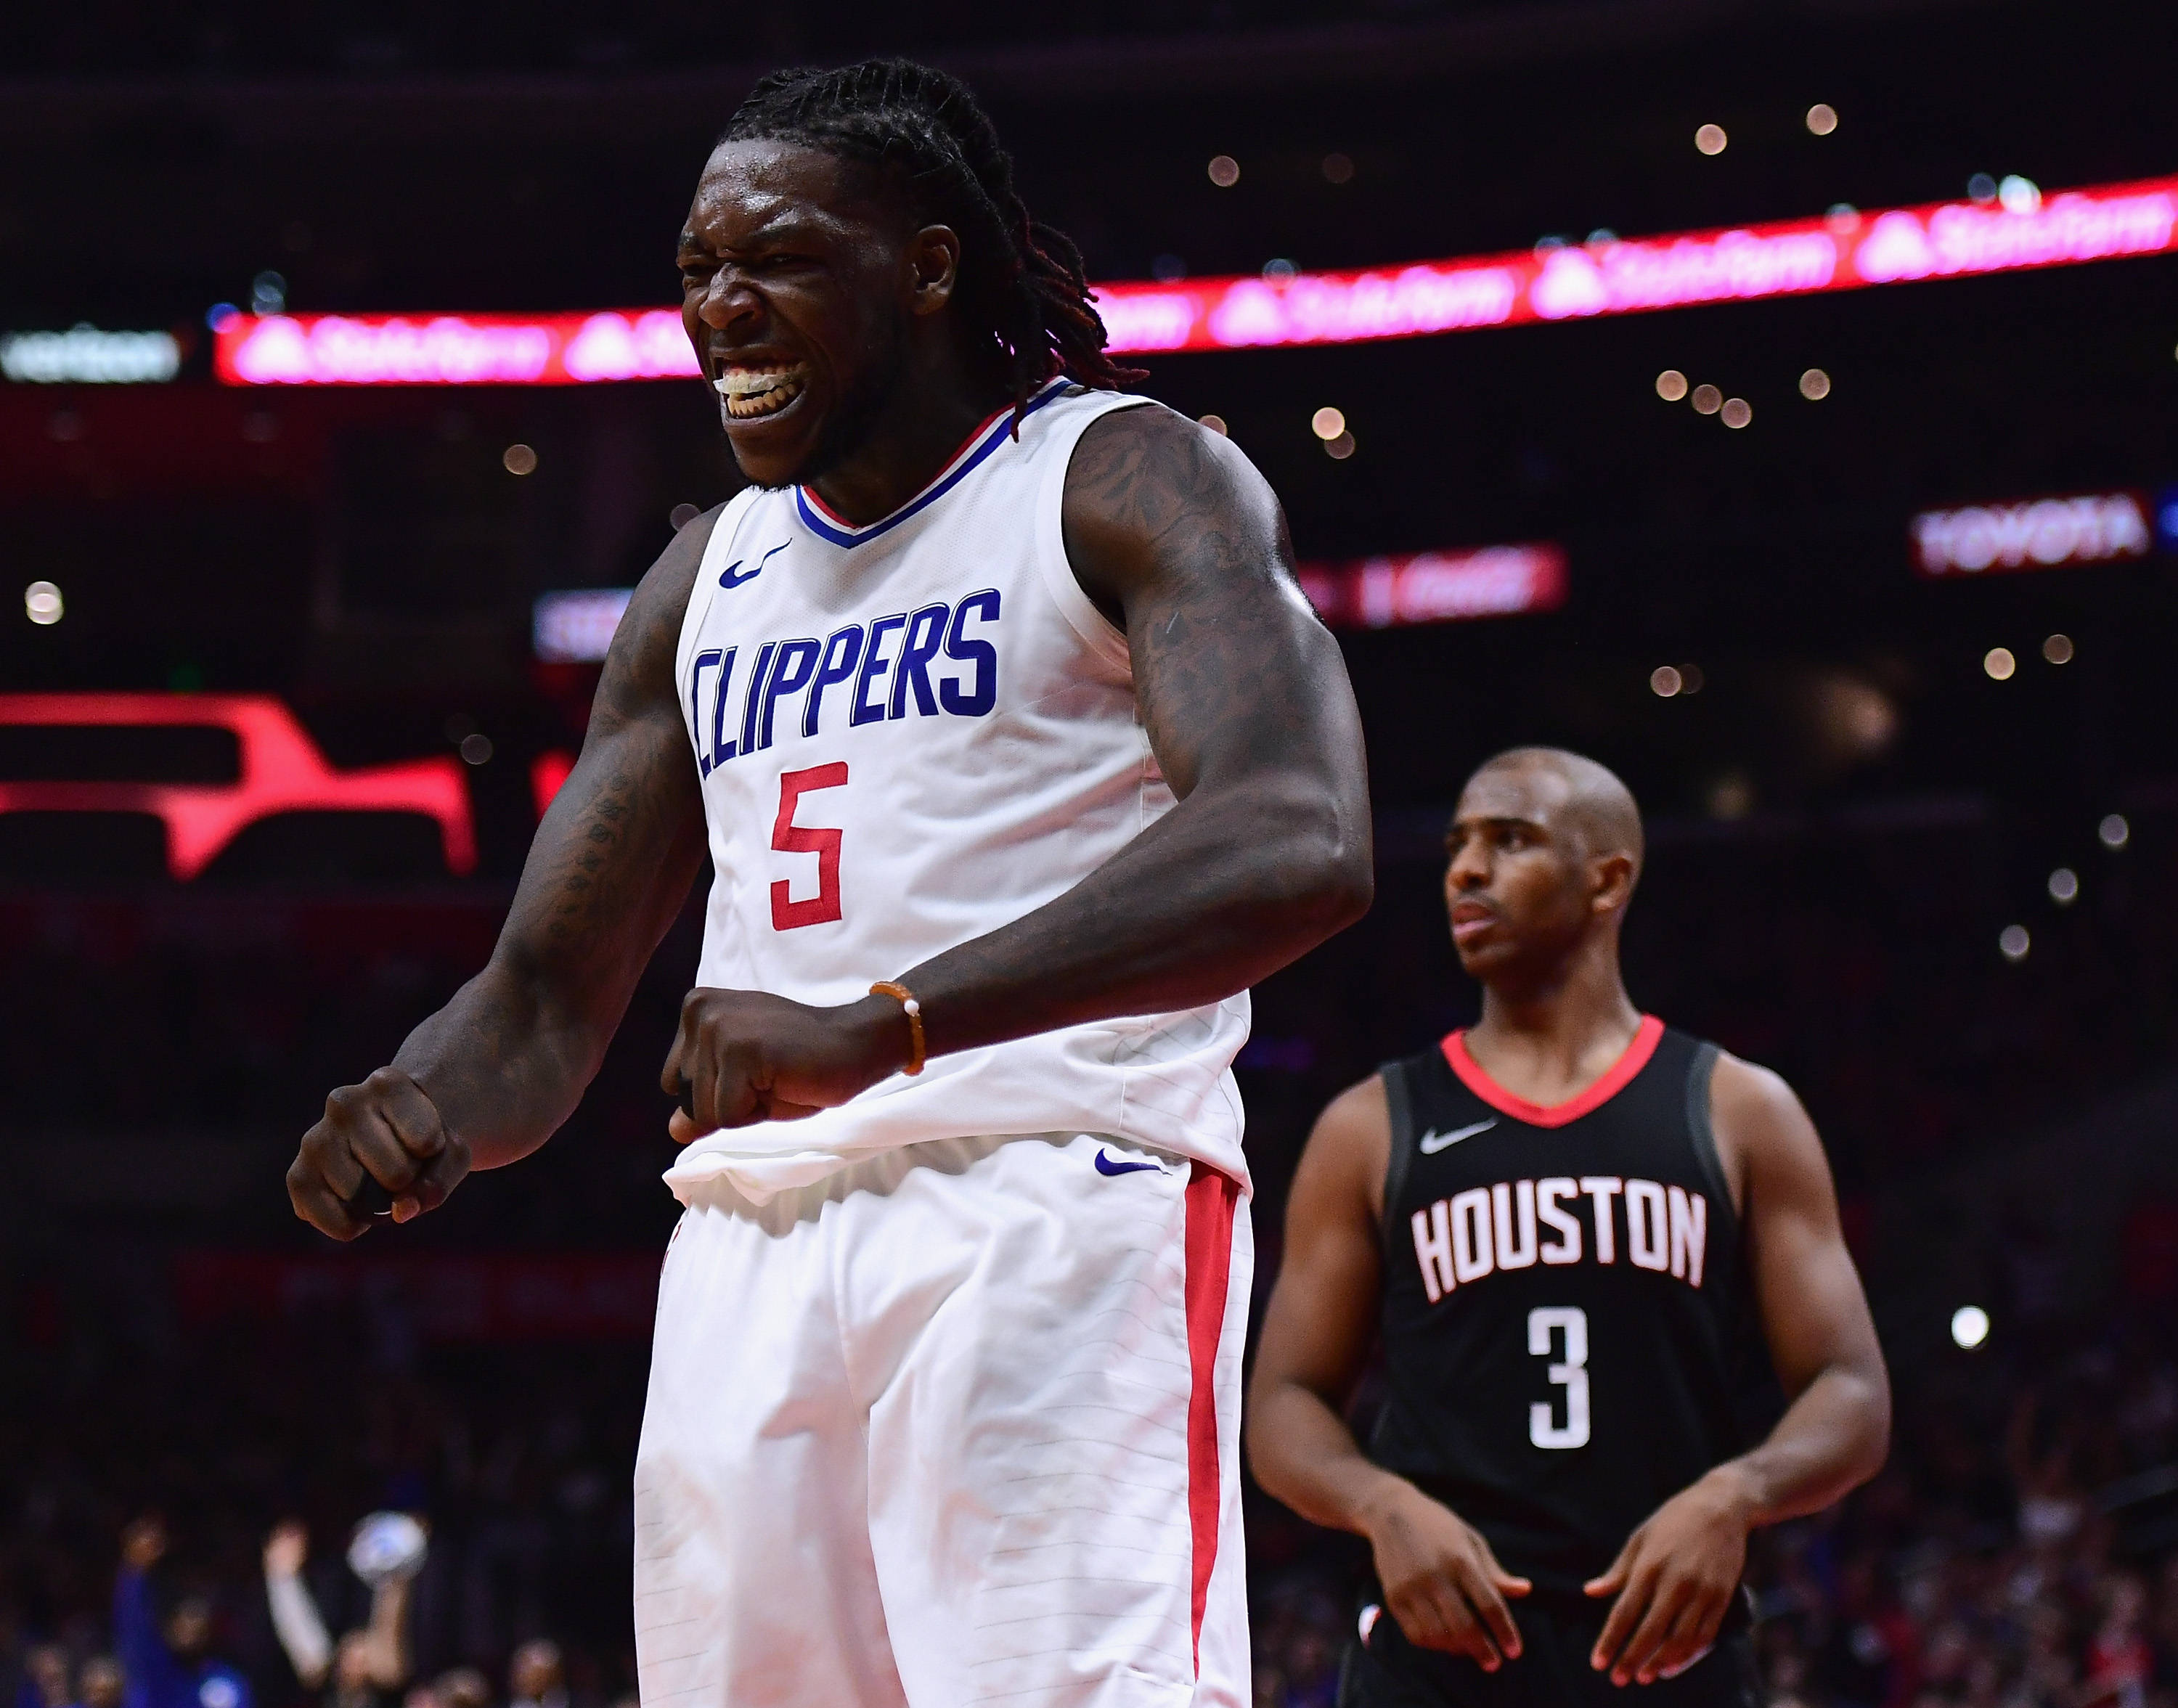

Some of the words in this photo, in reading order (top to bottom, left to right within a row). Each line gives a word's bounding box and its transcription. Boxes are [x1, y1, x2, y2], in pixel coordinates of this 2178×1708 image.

[691, 588, 1000, 781] CLIPPERS
[770, 761, 848, 931] 5
[1411, 1176, 1707, 1304] HOUSTON
[1527, 1306, 1591, 1450] 3
